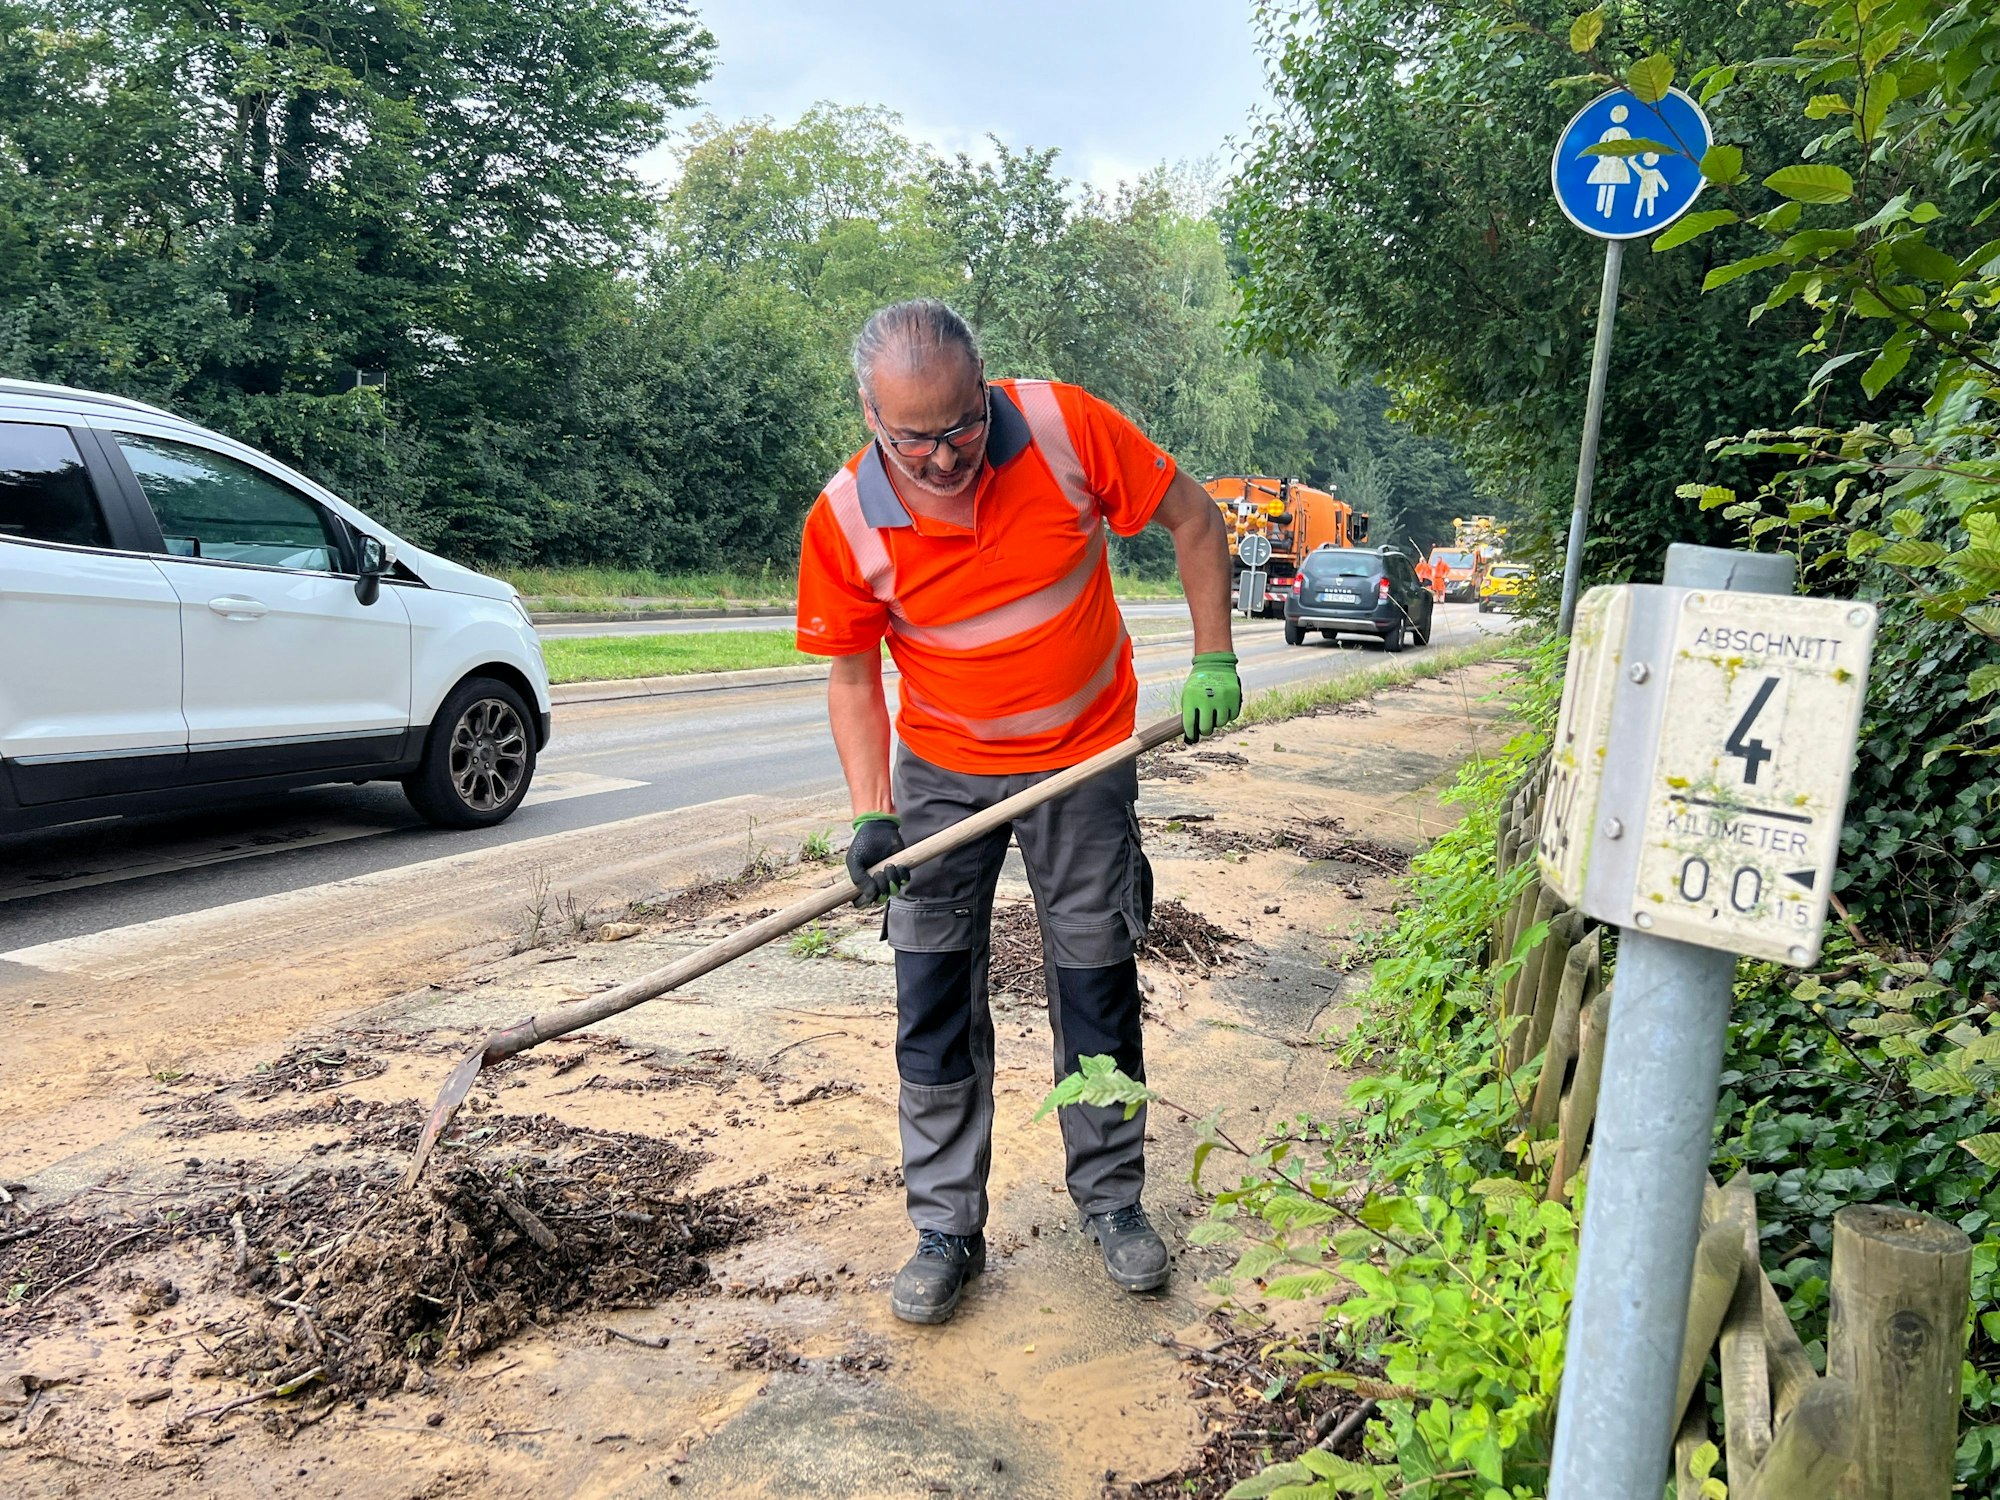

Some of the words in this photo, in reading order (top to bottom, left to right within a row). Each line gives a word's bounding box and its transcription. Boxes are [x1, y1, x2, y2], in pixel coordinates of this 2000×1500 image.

[1695, 626, 1842, 661] ABSCHNITT
[1725, 677, 1780, 785] 4
[1666, 811, 1808, 854] KILOMETER
